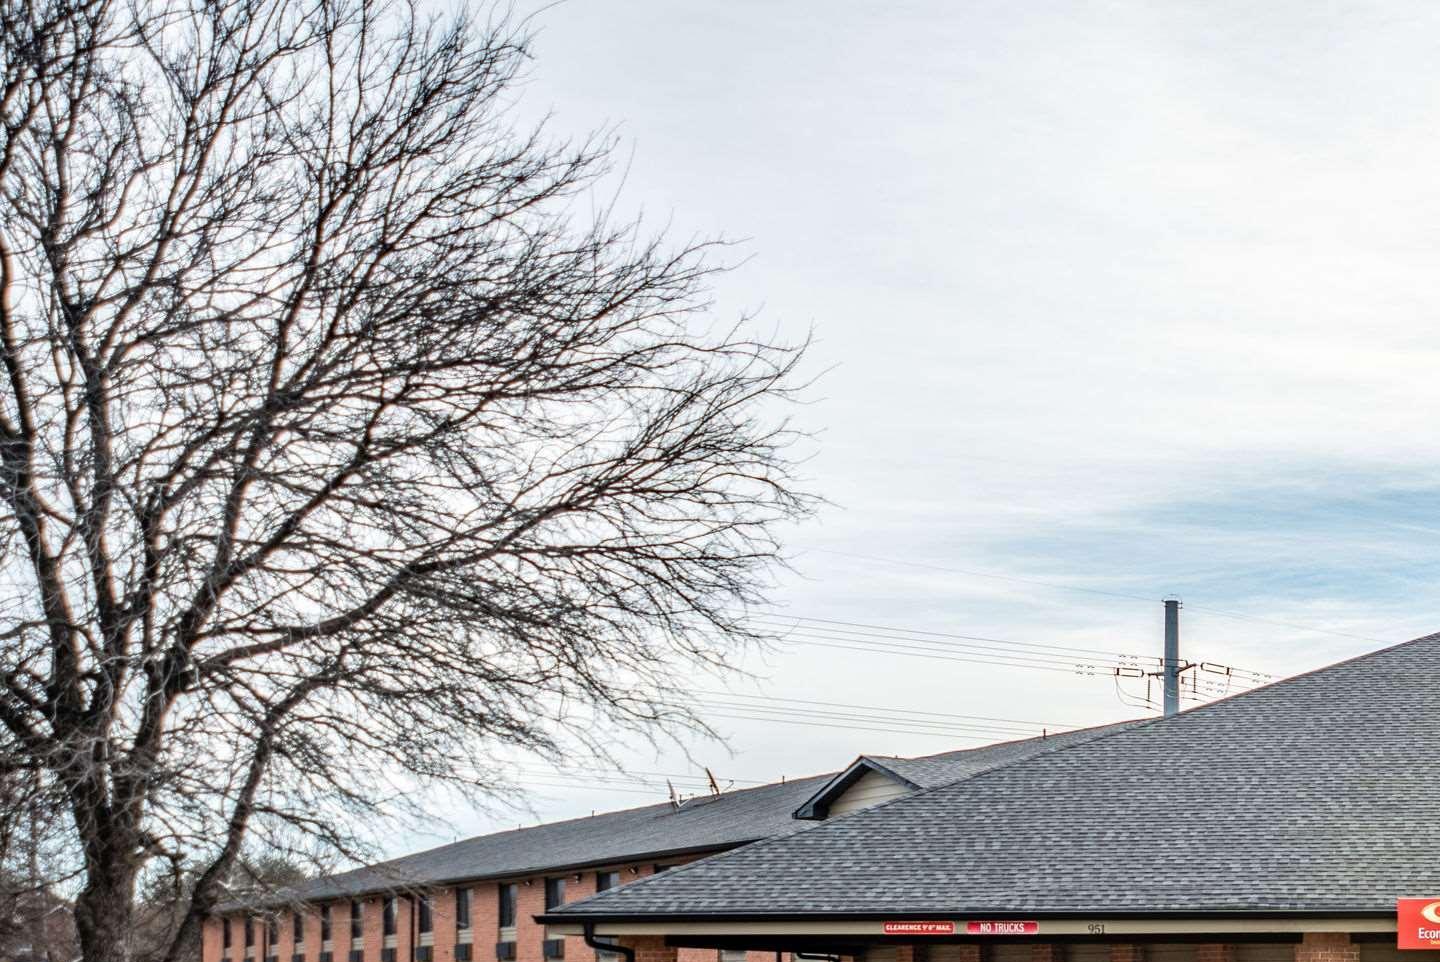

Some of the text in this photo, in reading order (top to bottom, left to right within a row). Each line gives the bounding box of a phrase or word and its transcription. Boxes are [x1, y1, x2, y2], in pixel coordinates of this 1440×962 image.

[980, 923, 1025, 933] NO TRUCKS
[1087, 923, 1105, 935] 951
